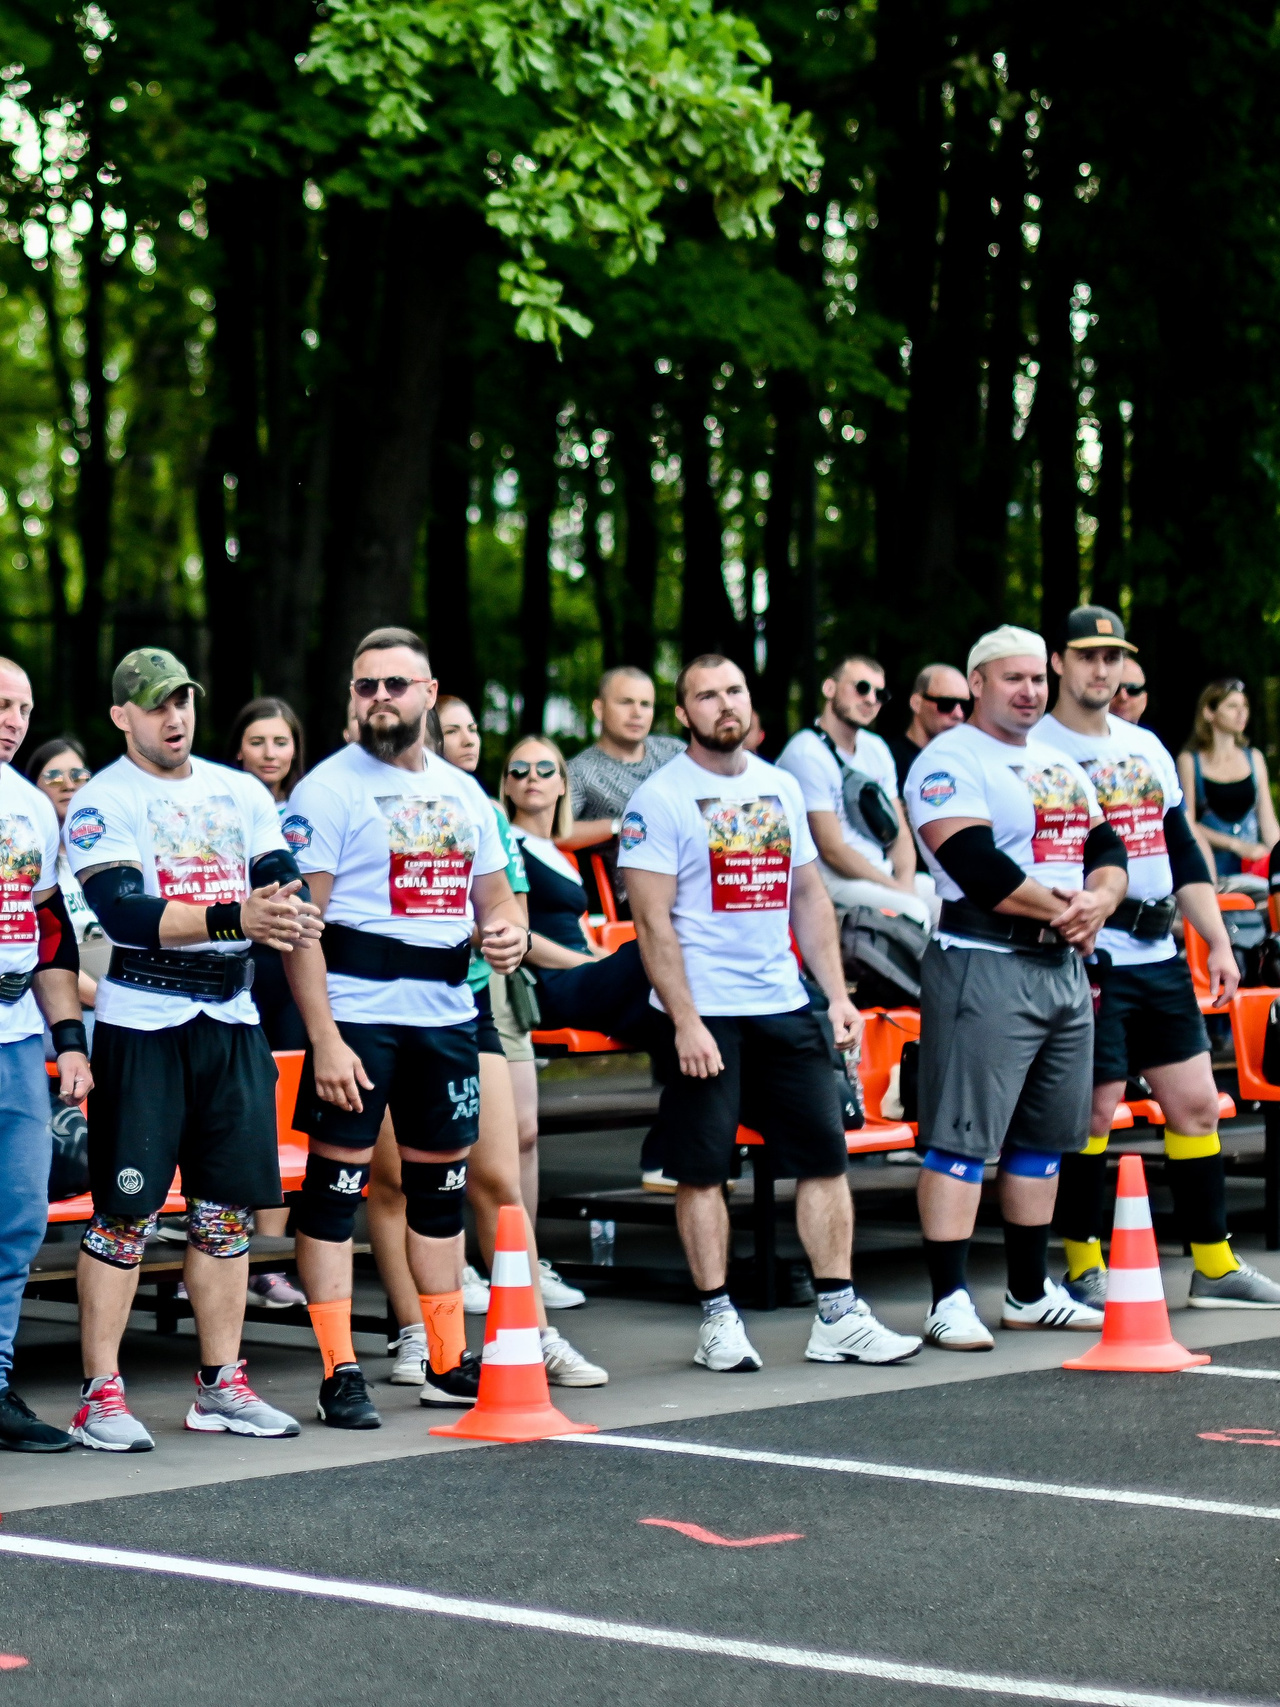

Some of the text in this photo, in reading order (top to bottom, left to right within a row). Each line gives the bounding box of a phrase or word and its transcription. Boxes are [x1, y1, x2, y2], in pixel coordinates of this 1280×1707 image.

[395, 876, 428, 888] СИЛА
[717, 873, 748, 885] СИЛА
[165, 881, 201, 897] СИЛА
